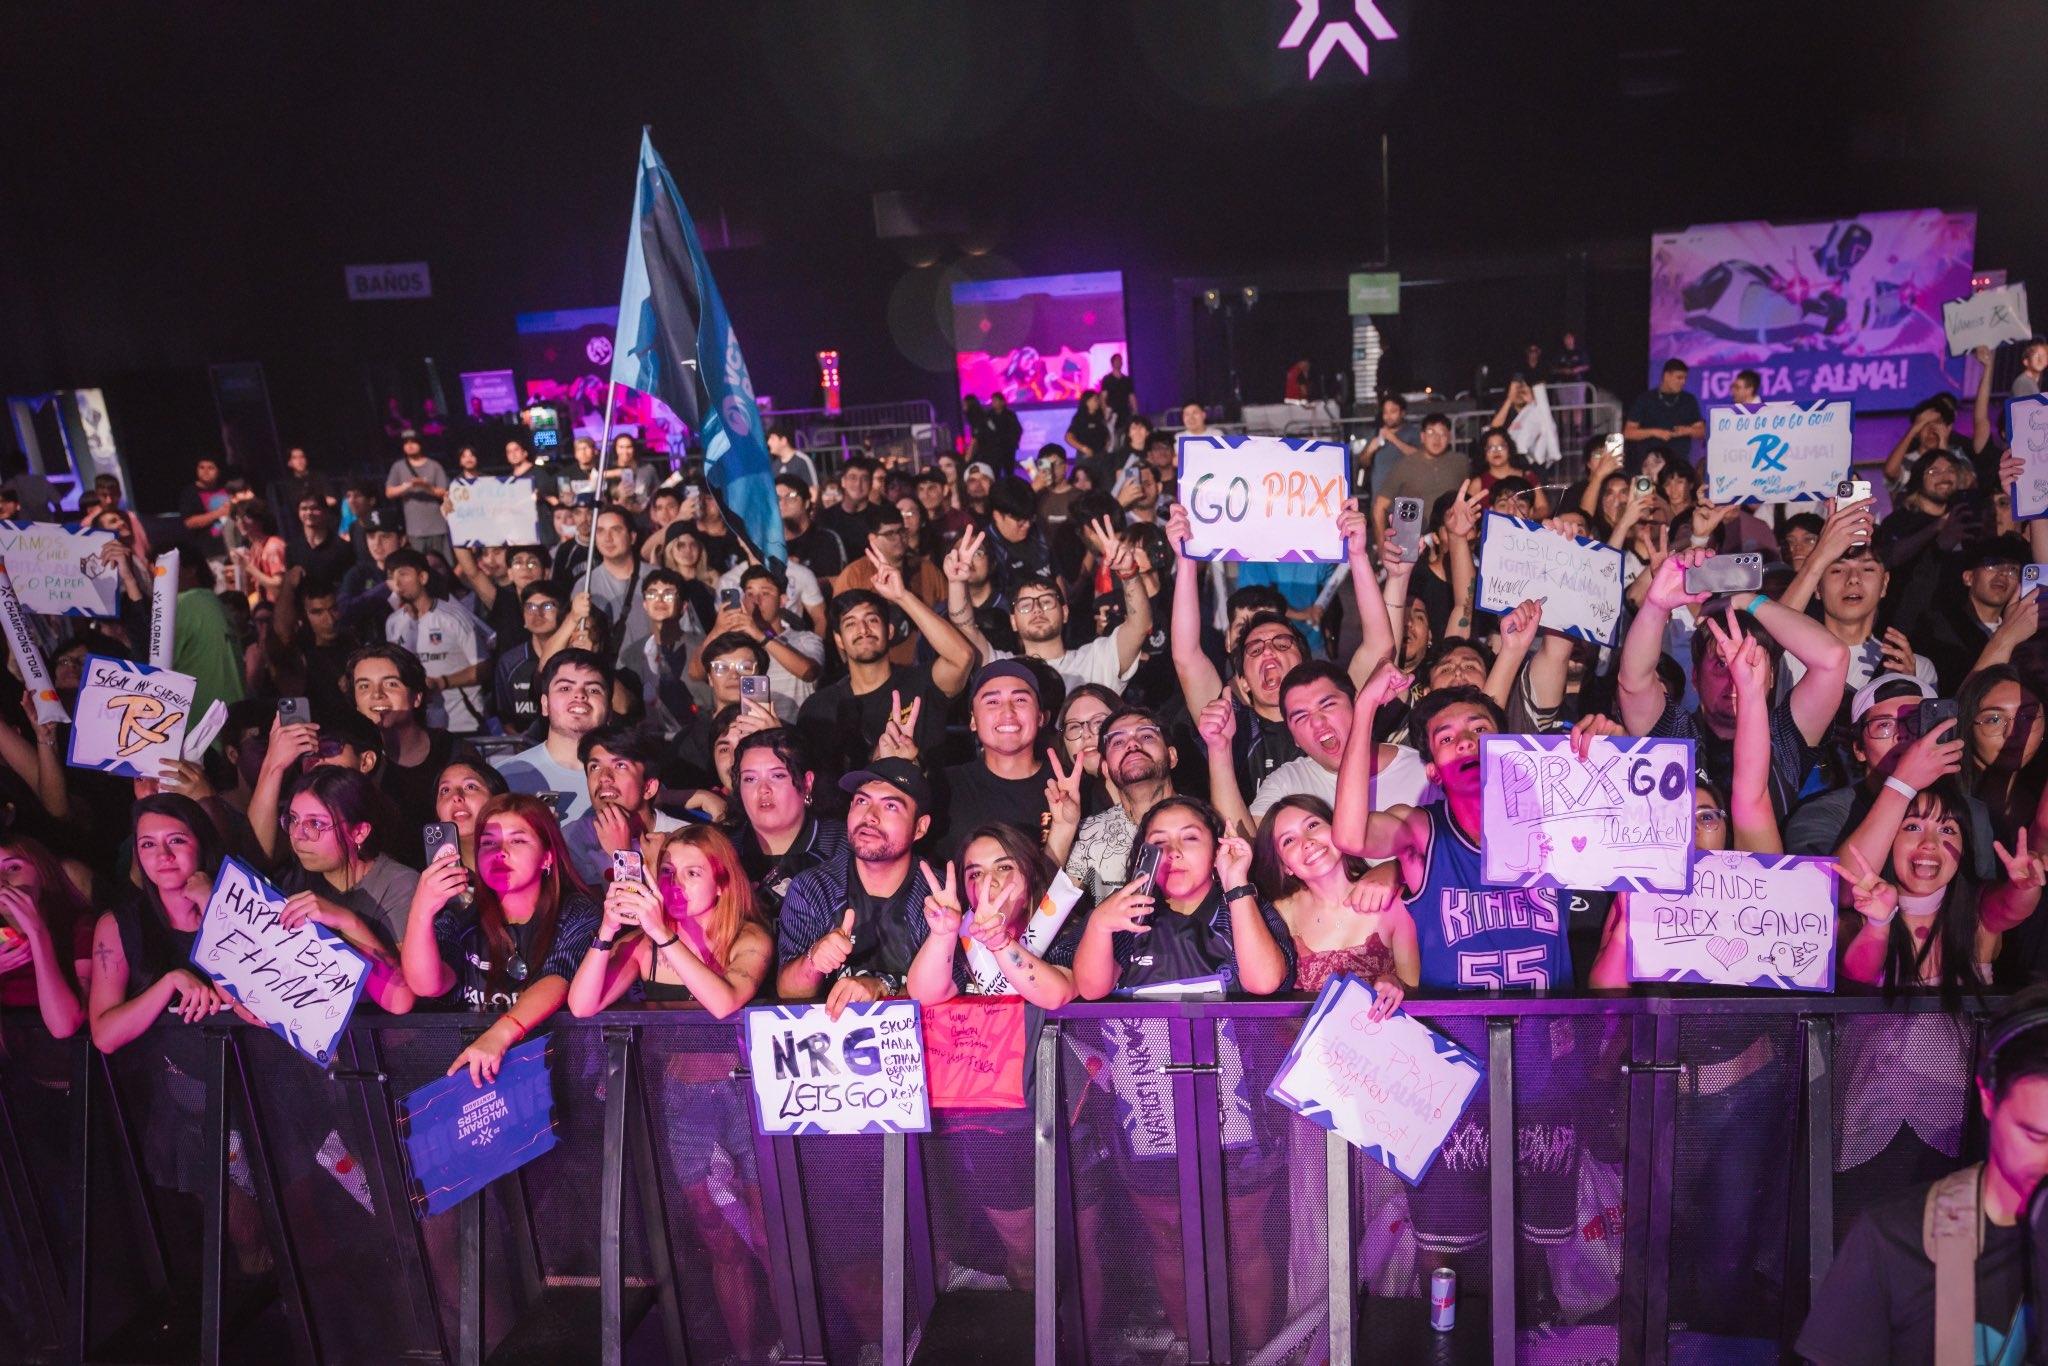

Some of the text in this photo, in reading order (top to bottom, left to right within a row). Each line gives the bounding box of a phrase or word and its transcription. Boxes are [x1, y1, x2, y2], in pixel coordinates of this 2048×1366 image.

[354, 270, 424, 293] BAÑOS
[1701, 366, 1794, 400] ¡GTA
[1811, 359, 1909, 393] ALMA!
[1736, 417, 1750, 431] GO
[1754, 416, 1768, 430] GO
[1772, 414, 1786, 430] GO
[1788, 412, 1804, 429] GO
[1190, 472, 1251, 525] GO
[0, 535, 65, 552] VAMOS
[36, 549, 71, 562] CHILE
[44, 575, 85, 588] PAPER
[3, 600, 43, 679] CHAMPIONS TOUR
[151, 608, 164, 657] VALORANT
[1499, 750, 1625, 818] PRX
[1658, 870, 1768, 903] RANDE
[1440, 887, 1559, 948] KINGS
[771, 1026, 883, 1080] NRG
[457, 1097, 506, 1129] MASTERS
[778, 1080, 888, 1120] LETS GO
[458, 1106, 509, 1140] VALORANT
